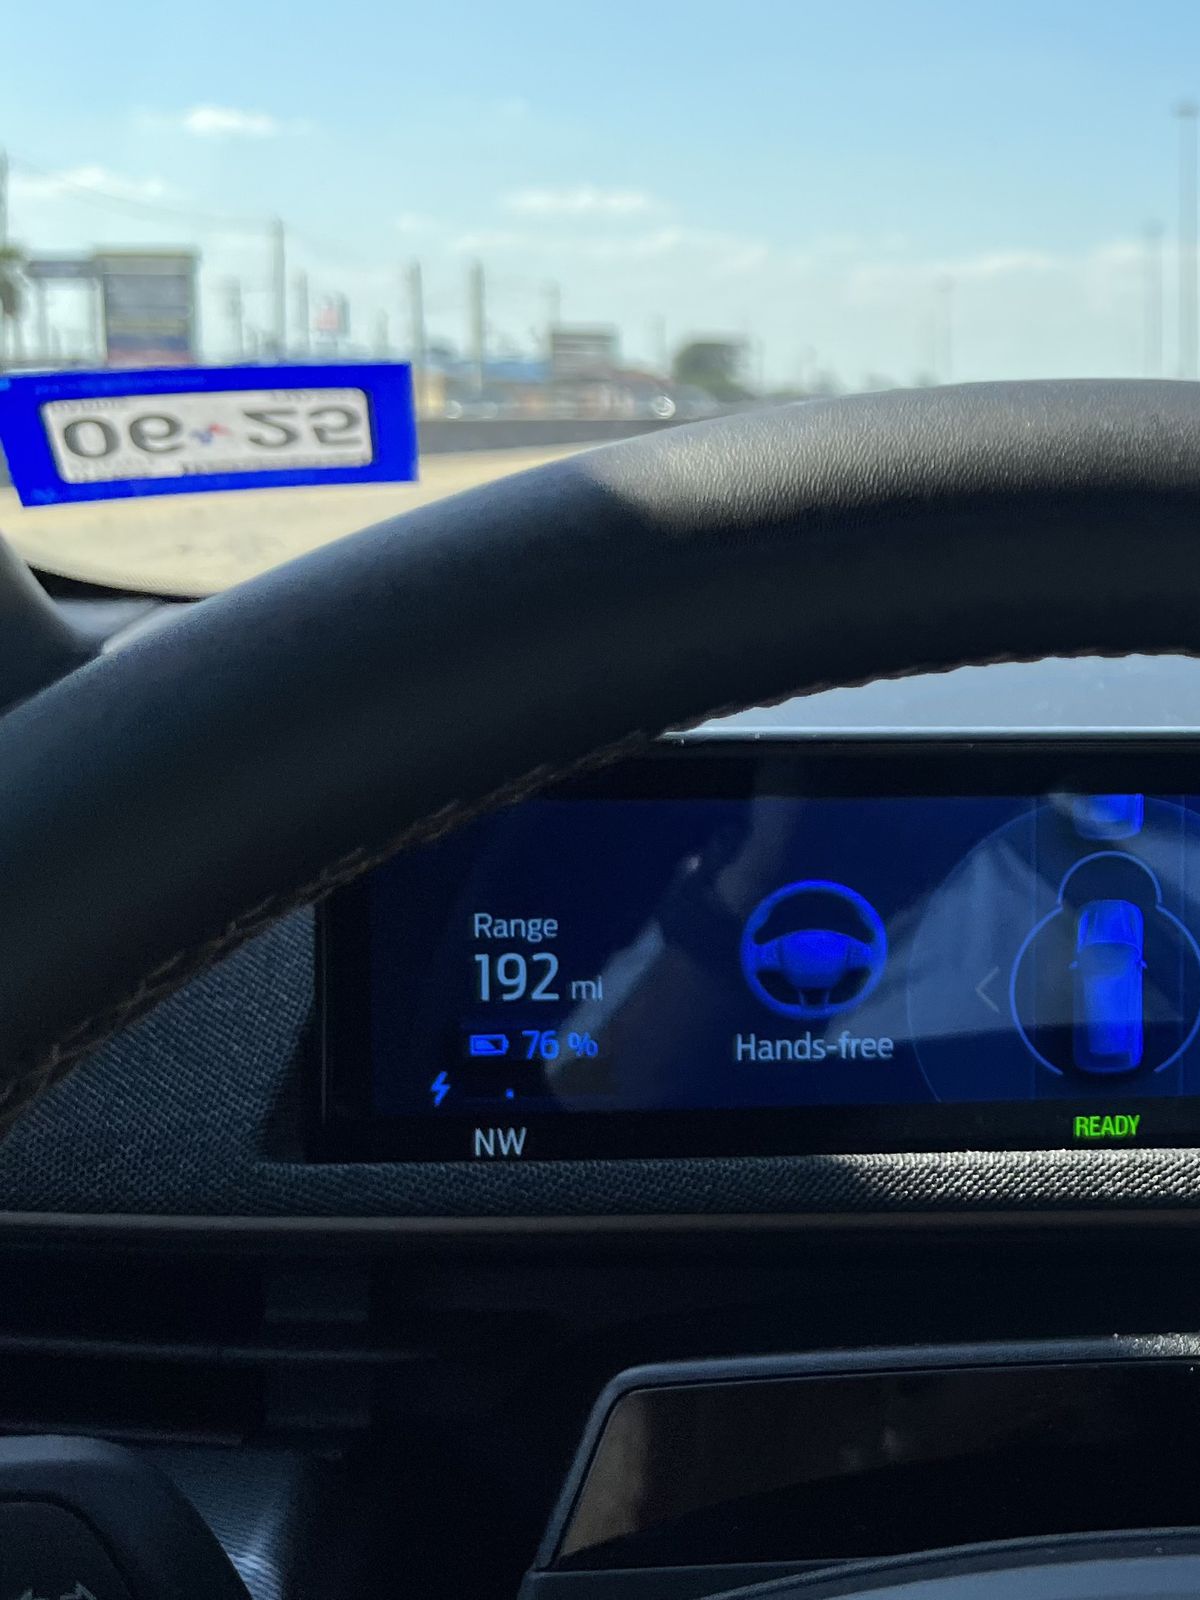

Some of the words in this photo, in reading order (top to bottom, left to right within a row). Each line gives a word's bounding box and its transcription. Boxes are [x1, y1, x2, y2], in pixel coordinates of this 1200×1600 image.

[473, 912, 559, 943] Range
[474, 952, 560, 1001] 192
[571, 974, 604, 1001] mi
[522, 1030, 560, 1060] 76
[567, 1031, 600, 1057] %
[735, 1031, 895, 1061] Hands-free
[1074, 1114, 1141, 1137] READY
[474, 1126, 527, 1157] NW
